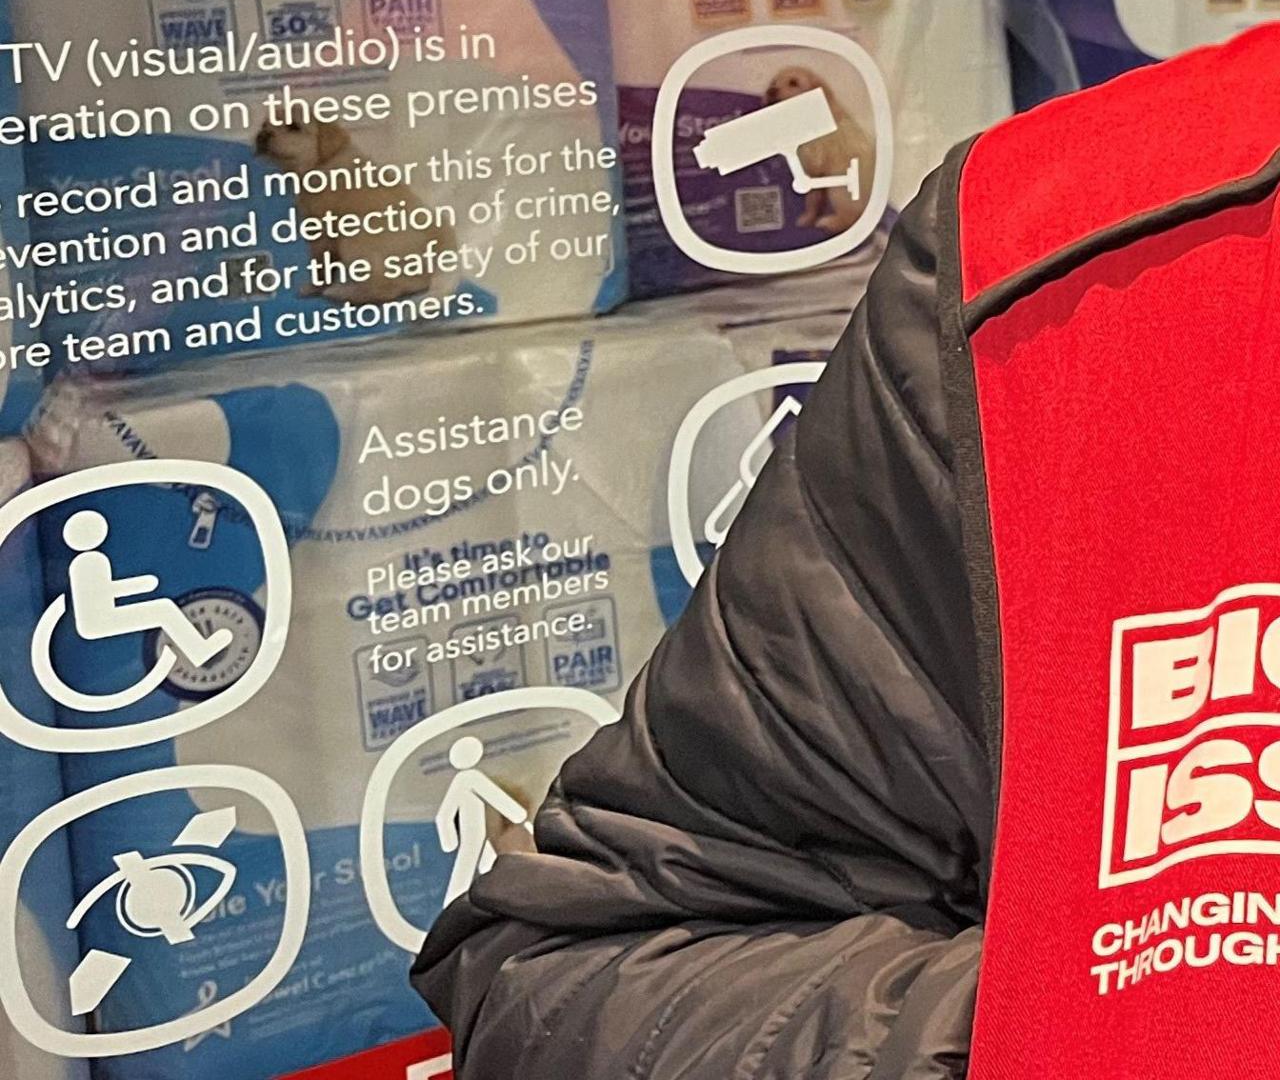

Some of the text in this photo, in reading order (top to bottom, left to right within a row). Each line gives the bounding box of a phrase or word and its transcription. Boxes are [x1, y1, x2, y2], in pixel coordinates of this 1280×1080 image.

[0, 40, 72, 85] TV
[86, 25, 403, 88] (visual/audio)
[414, 26, 446, 64] is
[459, 24, 497, 61] in
[0, 98, 172, 147] eration
[189, 95, 250, 134] on
[262, 84, 392, 128] these
[407, 74, 598, 127] premises
[17, 170, 158, 219] record
[172, 164, 250, 206] and
[264, 156, 418, 197] monitor
[428, 141, 494, 184] this
[502, 139, 552, 178] for
[560, 139, 617, 172] the
[180, 211, 258, 254] and
[271, 198, 457, 247] detection
[469, 187, 505, 224] of
[515, 184, 622, 220] crime,
[151, 261, 229, 305] and
[240, 257, 299, 295] for
[307, 250, 372, 287] the
[383, 238, 493, 284] safety
[504, 234, 541, 268] of
[550, 231, 610, 263] our
[63, 327, 172, 364] team
[185, 307, 263, 350] and
[275, 291, 486, 338] customers.
[358, 405, 584, 465] Assistance
[362, 449, 582, 517] dogs only.
[366, 534, 593, 597] Please ask our
[369, 570, 609, 636] team members
[369, 611, 594, 674] for assistance.
[552, 645, 614, 672] PAIR
